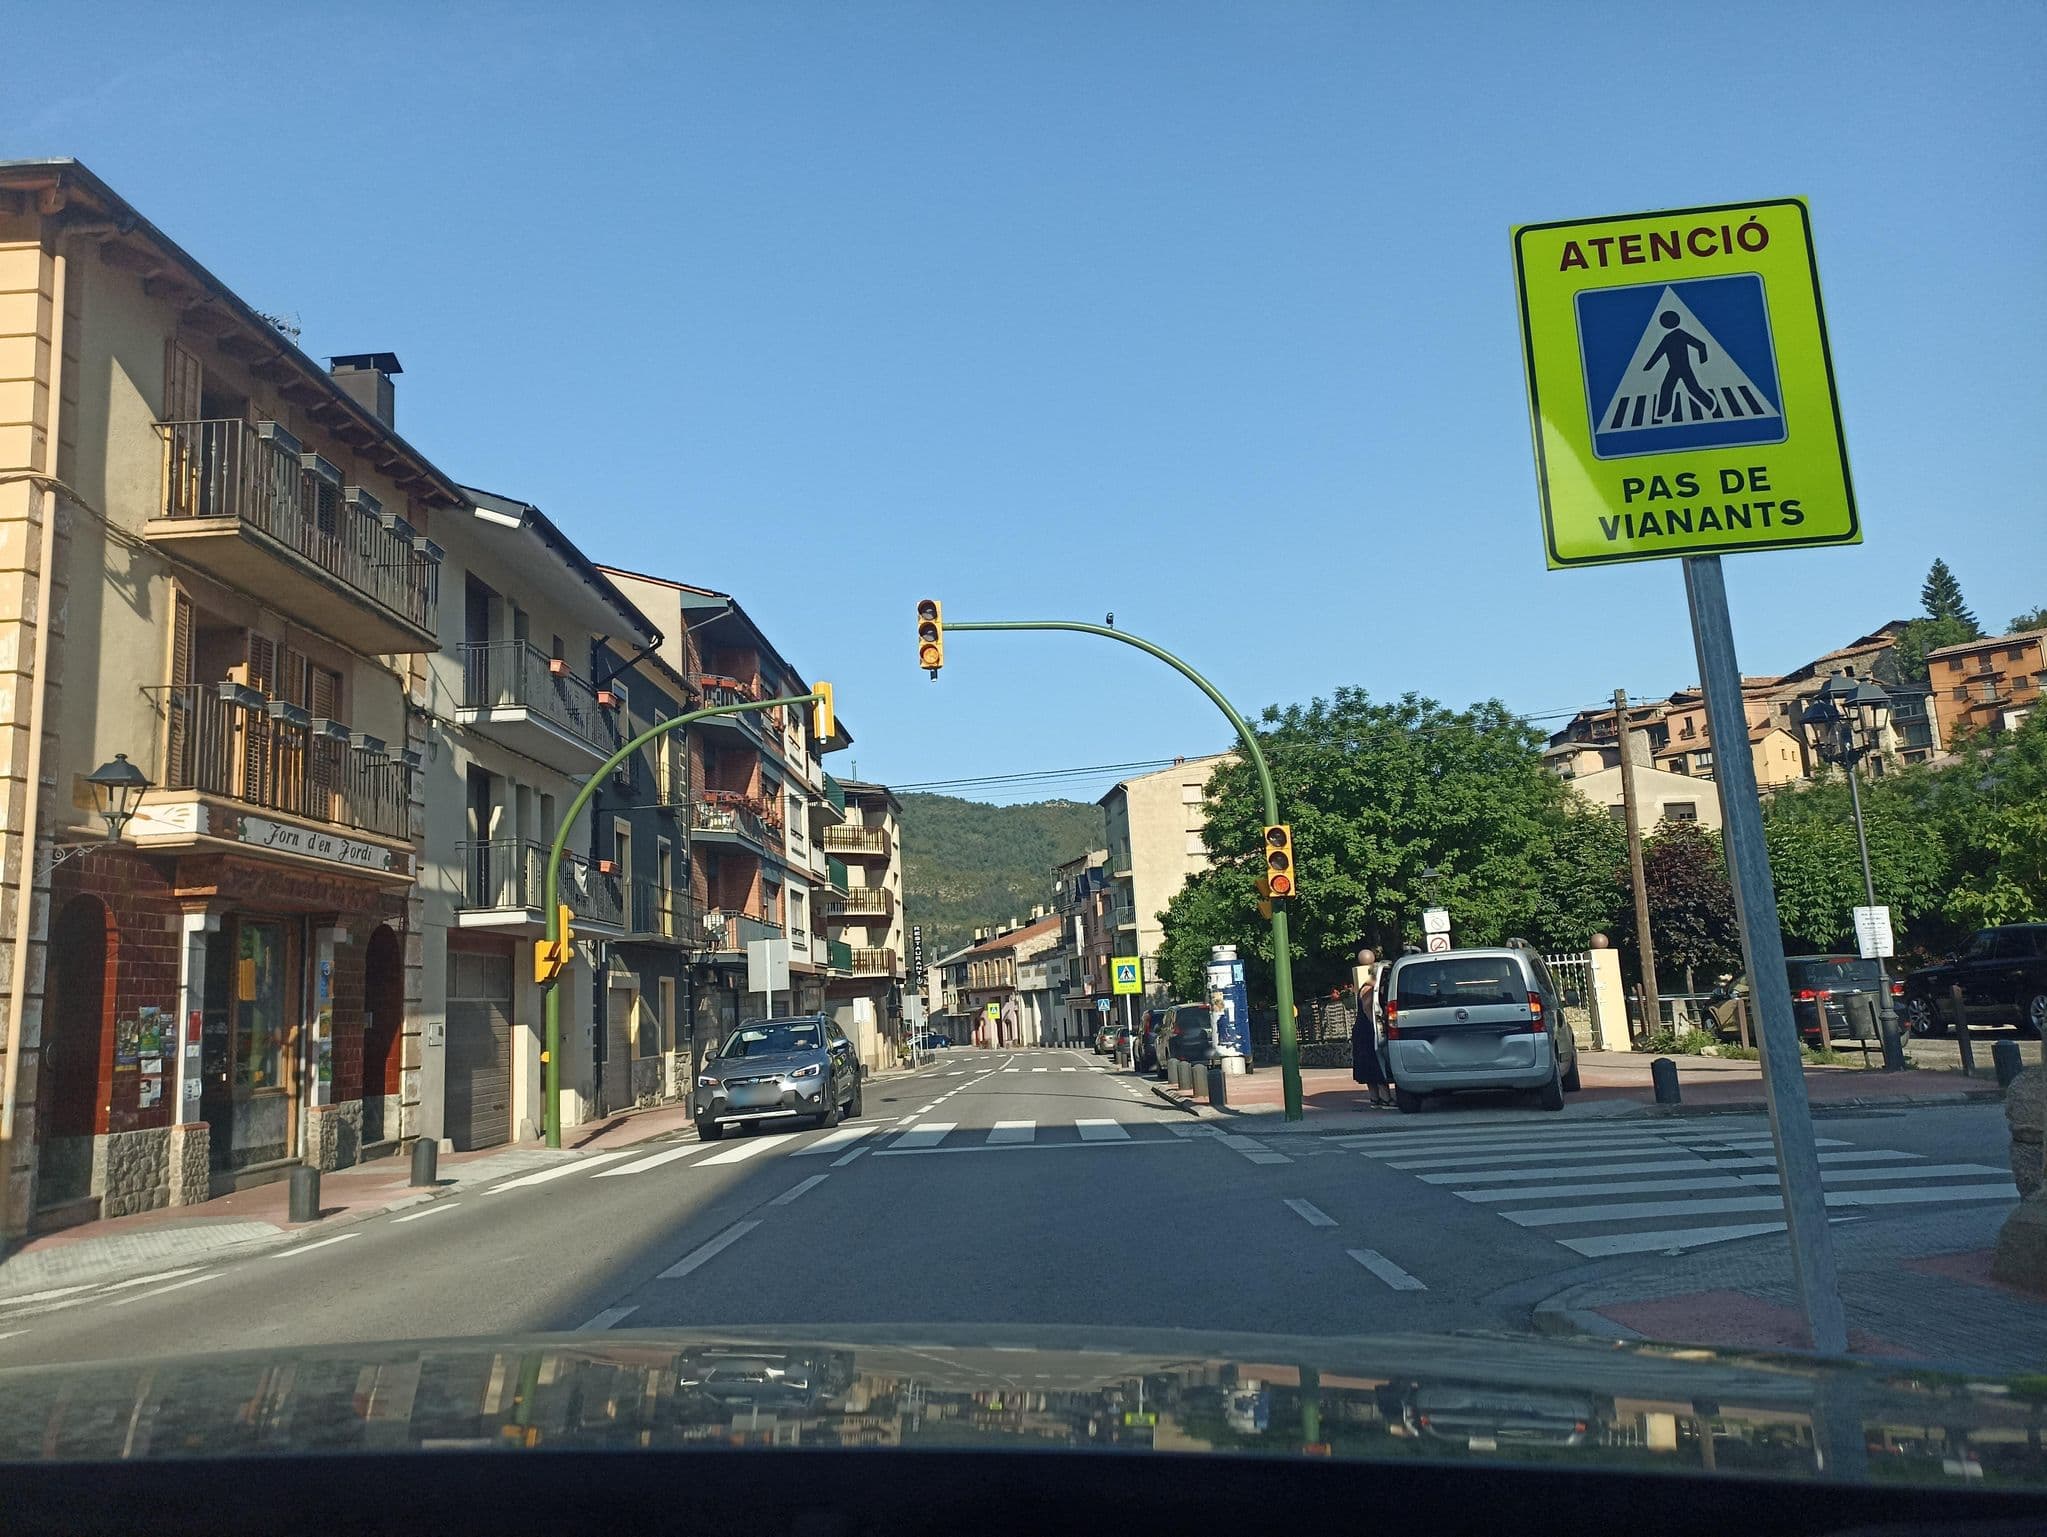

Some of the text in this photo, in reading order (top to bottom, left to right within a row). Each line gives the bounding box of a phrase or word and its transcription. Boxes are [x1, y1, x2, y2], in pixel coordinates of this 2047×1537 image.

[1559, 215, 1769, 272] ATENCIÓ
[1622, 466, 1771, 503] PAS DE
[1599, 500, 1805, 541] VIANANTS
[338, 840, 373, 863] Jordi
[913, 926, 923, 976] RESTAURANT
